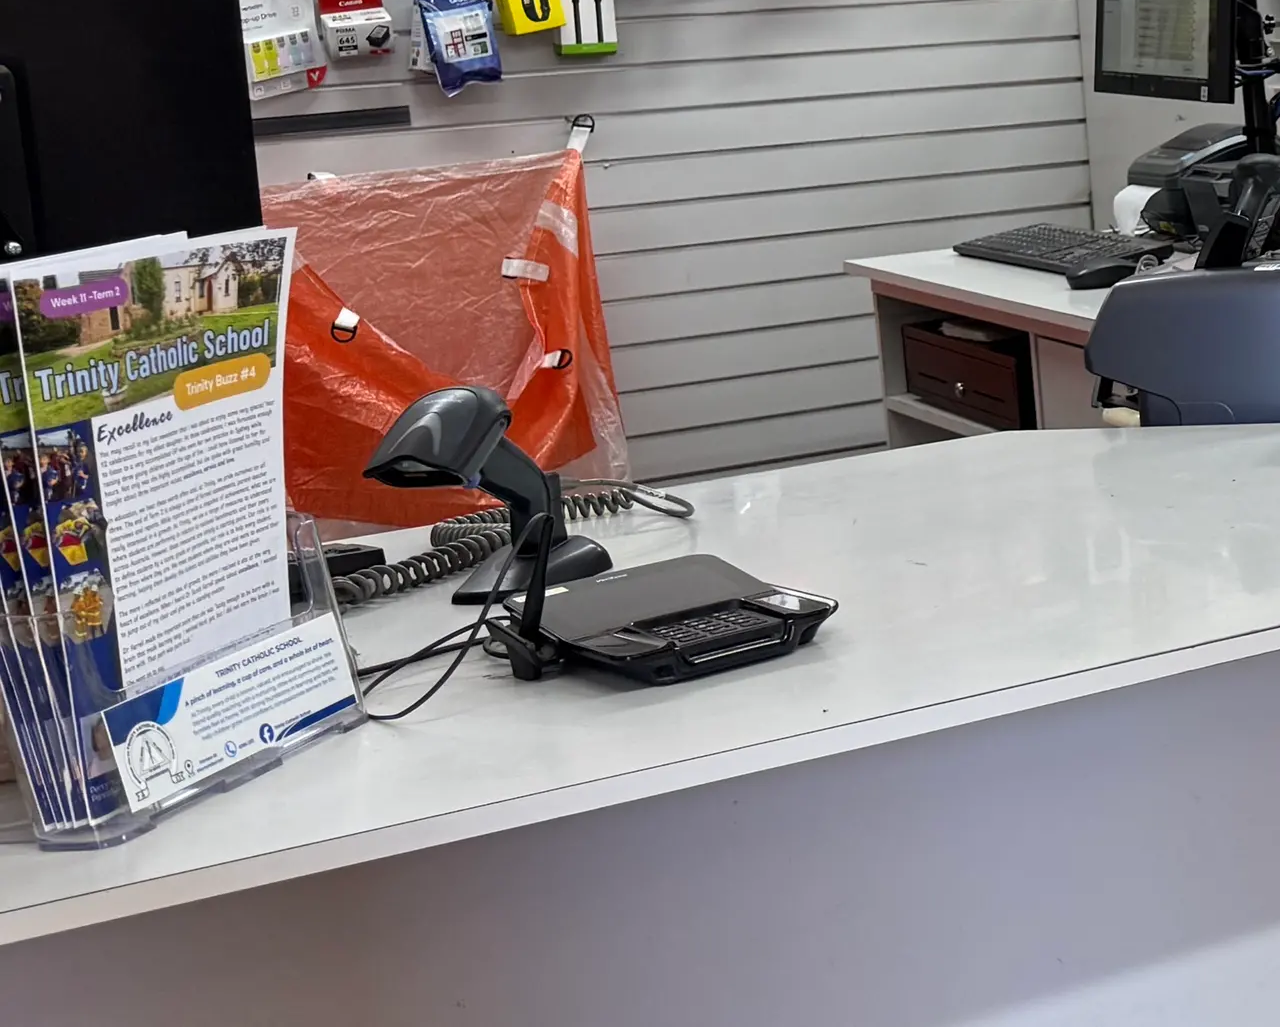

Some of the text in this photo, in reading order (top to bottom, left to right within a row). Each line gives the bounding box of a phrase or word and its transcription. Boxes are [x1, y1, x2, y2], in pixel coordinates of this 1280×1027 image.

[50, 296, 78, 308] Week
[115, 286, 120, 297] 2
[34, 319, 270, 402] Trinity Catholic School
[186, 366, 256, 396] Trinity Buzz #4
[97, 410, 173, 444] Excellence
[216, 637, 303, 678] TRINITY CATHOLIC SCHOOL
